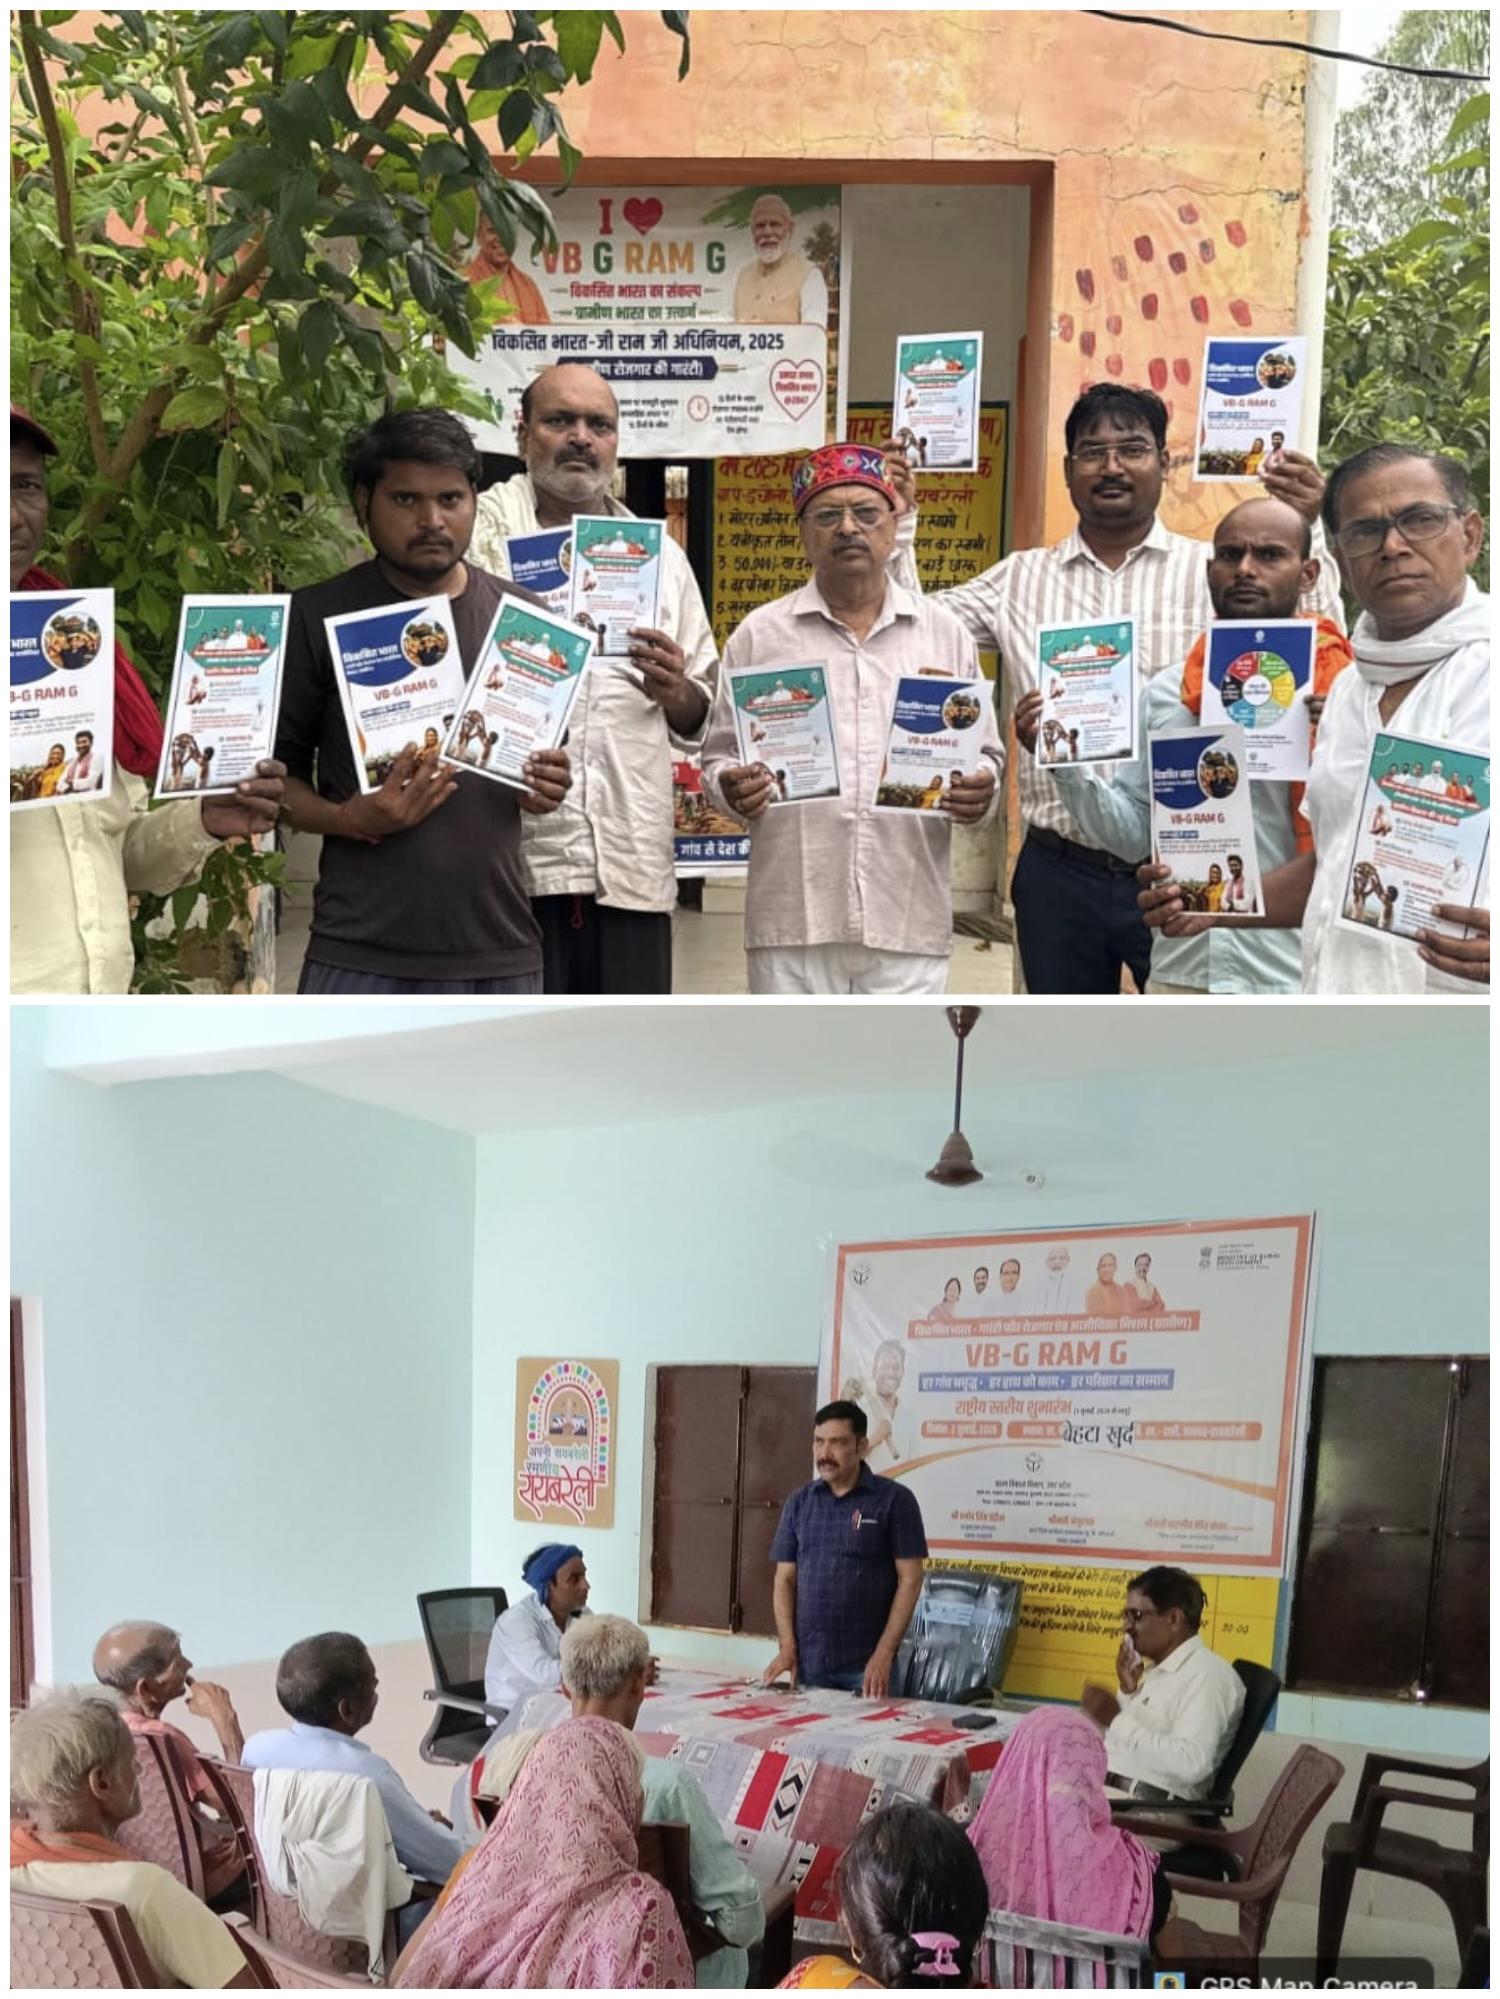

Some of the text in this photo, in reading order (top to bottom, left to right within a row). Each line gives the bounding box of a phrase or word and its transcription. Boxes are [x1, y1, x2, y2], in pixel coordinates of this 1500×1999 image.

[599, 199, 613, 235] I
[542, 240, 726, 274] VB G RAM G
[570, 280, 702, 298] विकसित भारत का संकल्प
[575, 303, 612, 320] ग्रामीण
[616, 306, 644, 319] भारत
[649, 306, 662, 319] का
[492, 329, 784, 352] विकसित भारत-जी राम जी अधिनियम, 2025
[614, 360, 651, 376] रोजगार
[654, 360, 668, 376] की
[35, 686, 66, 701] RAM
[68, 685, 78, 698] G
[402, 679, 428, 694] RAM
[429, 679, 438, 689] G
[1217, 812, 1226, 824] G
[718, 840, 736, 857] देश
[966, 1339, 1127, 1368] VB-G RAM G
[955, 1396, 986, 1418] राष्ट्रीय
[1026, 1397, 1073, 1420] शुभारंभ
[1063, 1420, 1100, 1444] बेहटा
[1105, 1420, 1135, 1449] खुर्द
[528, 1445, 589, 1461] अपनी रायबरेली
[525, 1460, 560, 1477] रमणीय
[519, 1465, 607, 1523] रायबरेली
